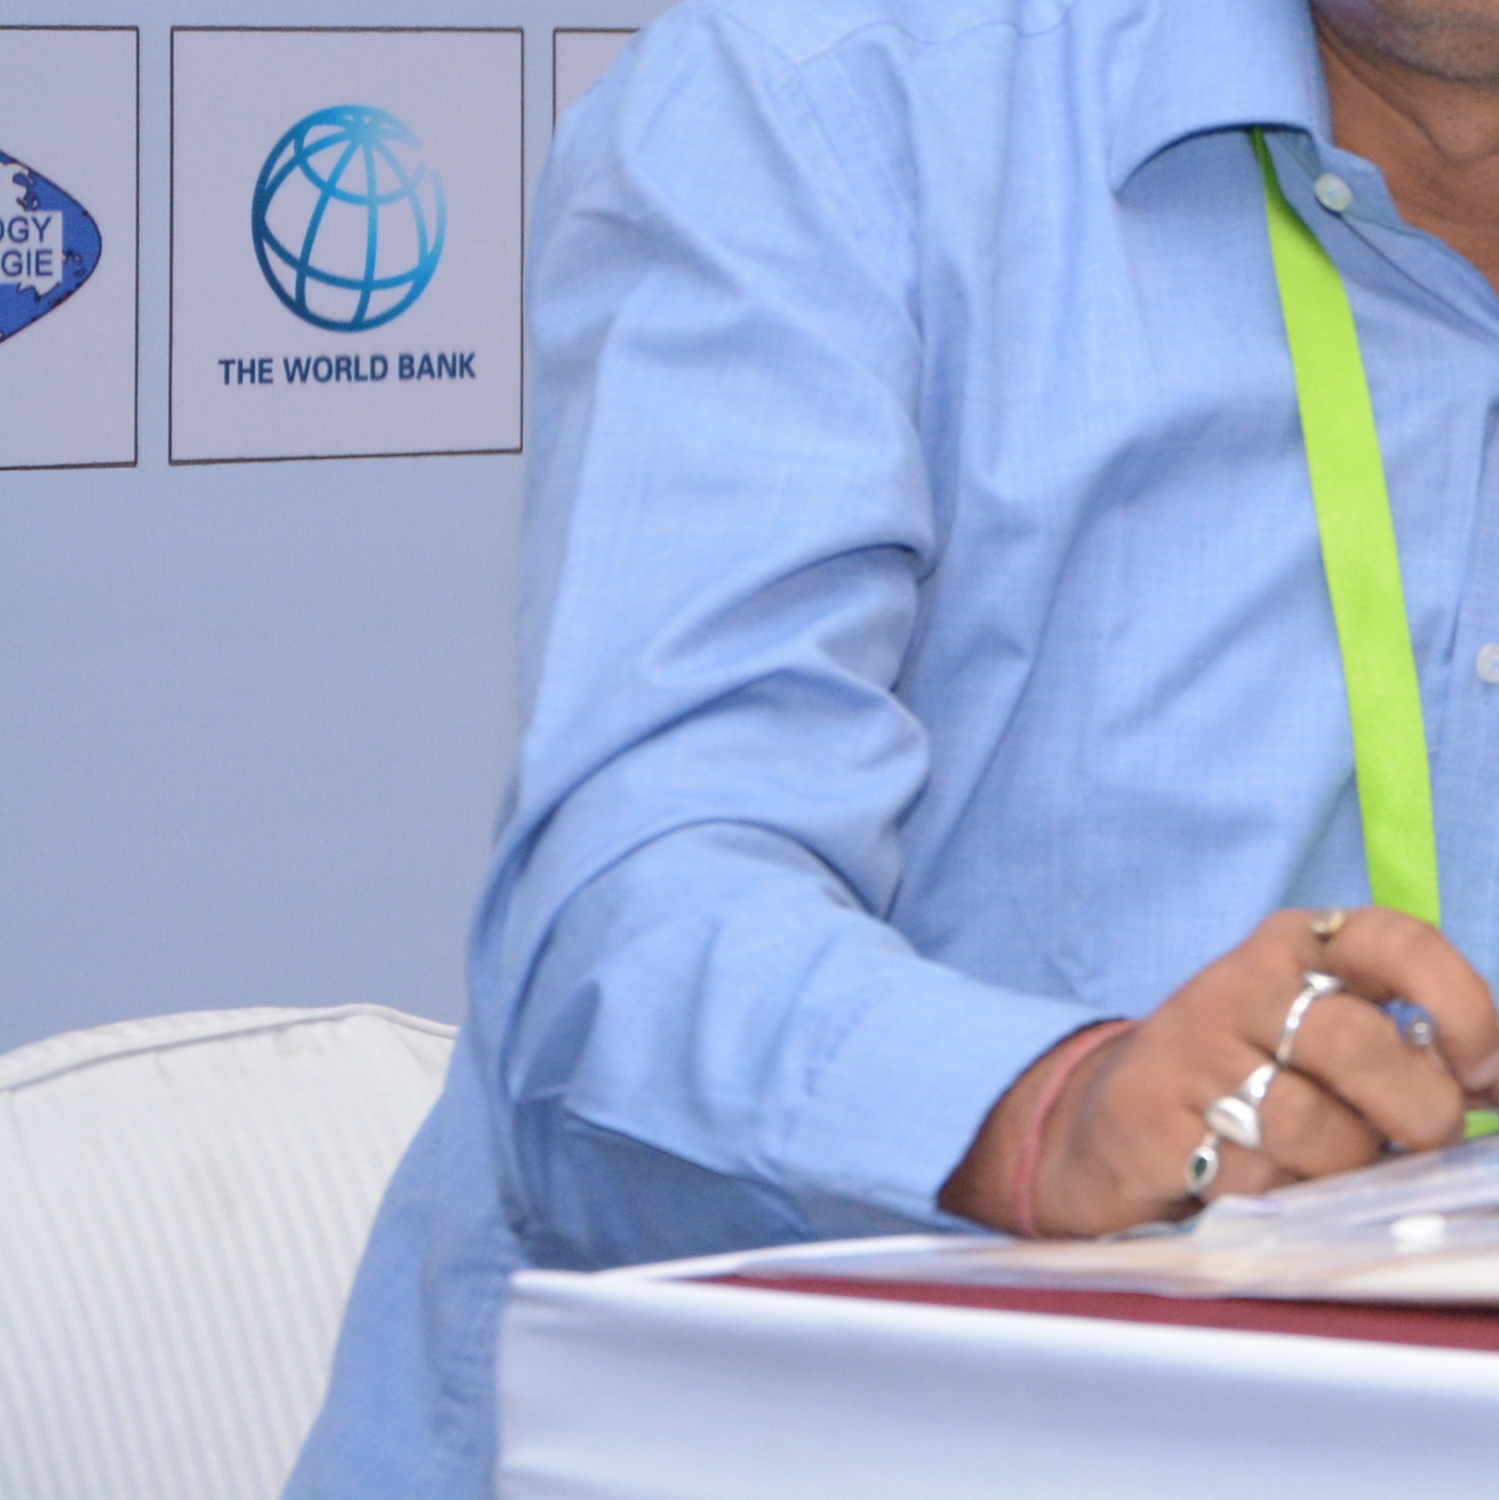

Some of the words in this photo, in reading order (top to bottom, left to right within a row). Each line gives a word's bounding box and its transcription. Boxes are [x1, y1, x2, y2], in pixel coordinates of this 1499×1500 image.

[218, 357, 274, 386] THE
[283, 354, 389, 384] WORLD
[398, 352, 476, 381] BANK
